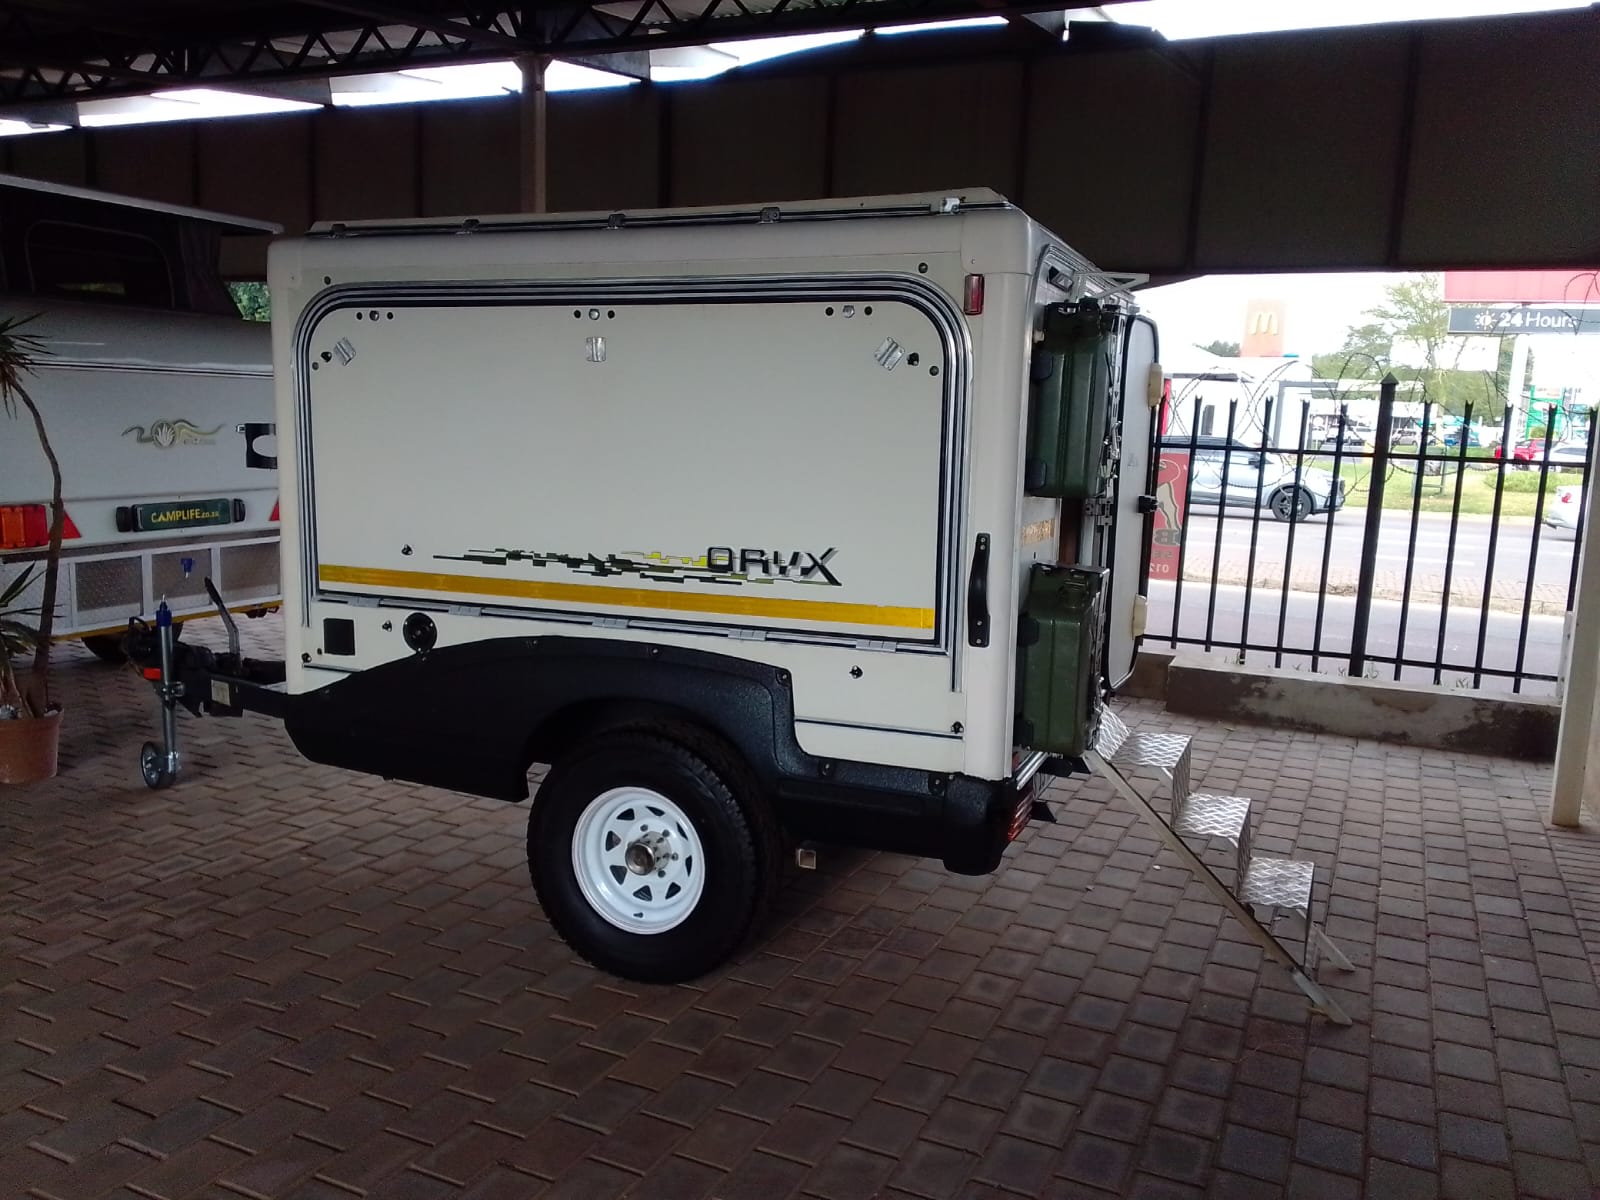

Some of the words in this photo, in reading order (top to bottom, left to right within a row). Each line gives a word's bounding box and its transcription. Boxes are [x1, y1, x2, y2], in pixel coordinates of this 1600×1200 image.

[1498, 312, 1523, 327] 24
[1525, 312, 1577, 328] Hours
[707, 546, 843, 586] ORYX
